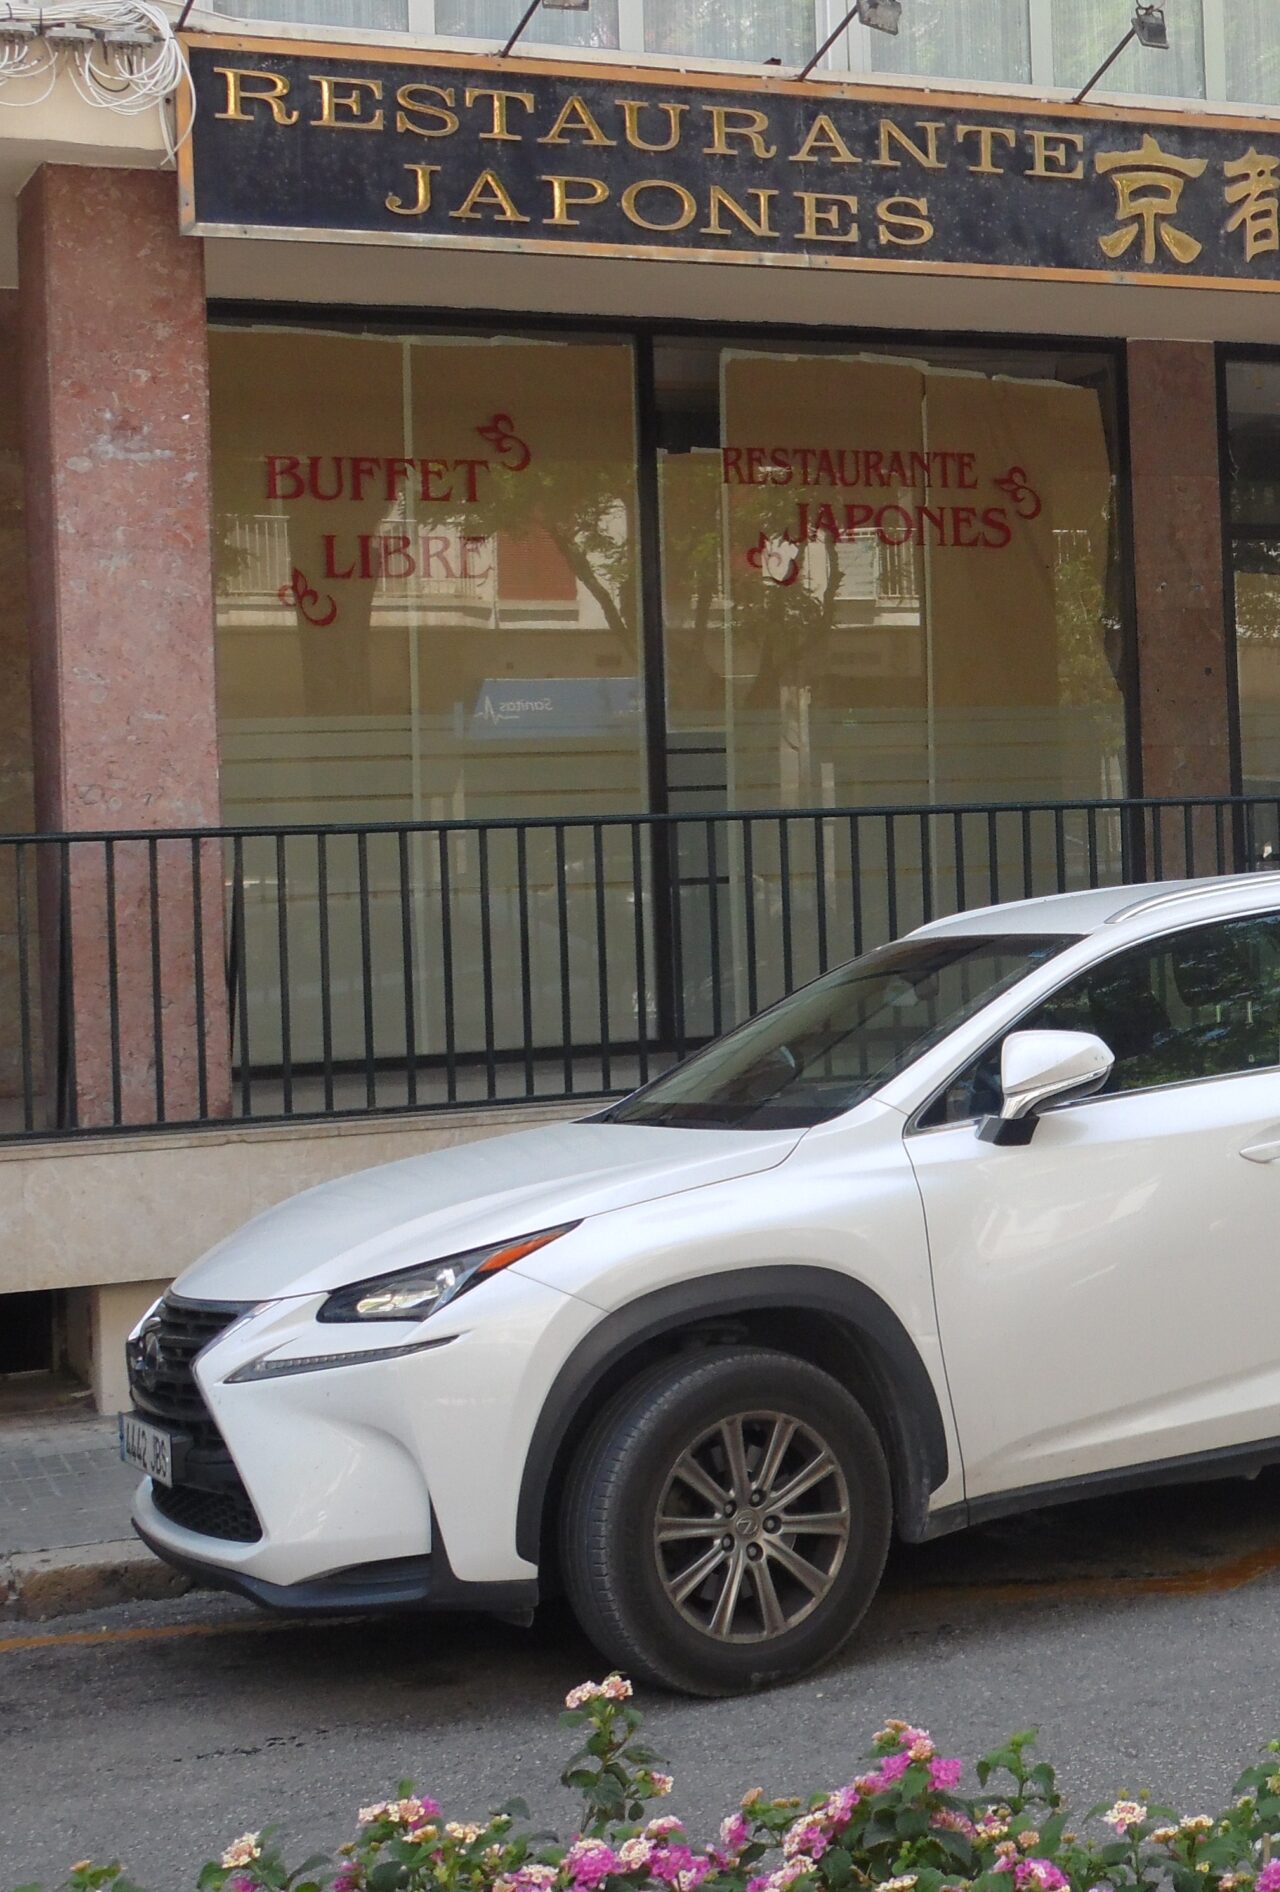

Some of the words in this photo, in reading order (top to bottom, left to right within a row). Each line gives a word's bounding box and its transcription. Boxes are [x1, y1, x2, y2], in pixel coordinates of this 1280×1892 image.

[212, 67, 1085, 179] RESTAURANTE
[385, 162, 935, 246] JAPONES
[265, 455, 490, 502] BUFFET
[722, 447, 979, 489] RESTAURANTE
[793, 503, 1012, 549] JAPONES
[323, 535, 493, 579] LIBRE
